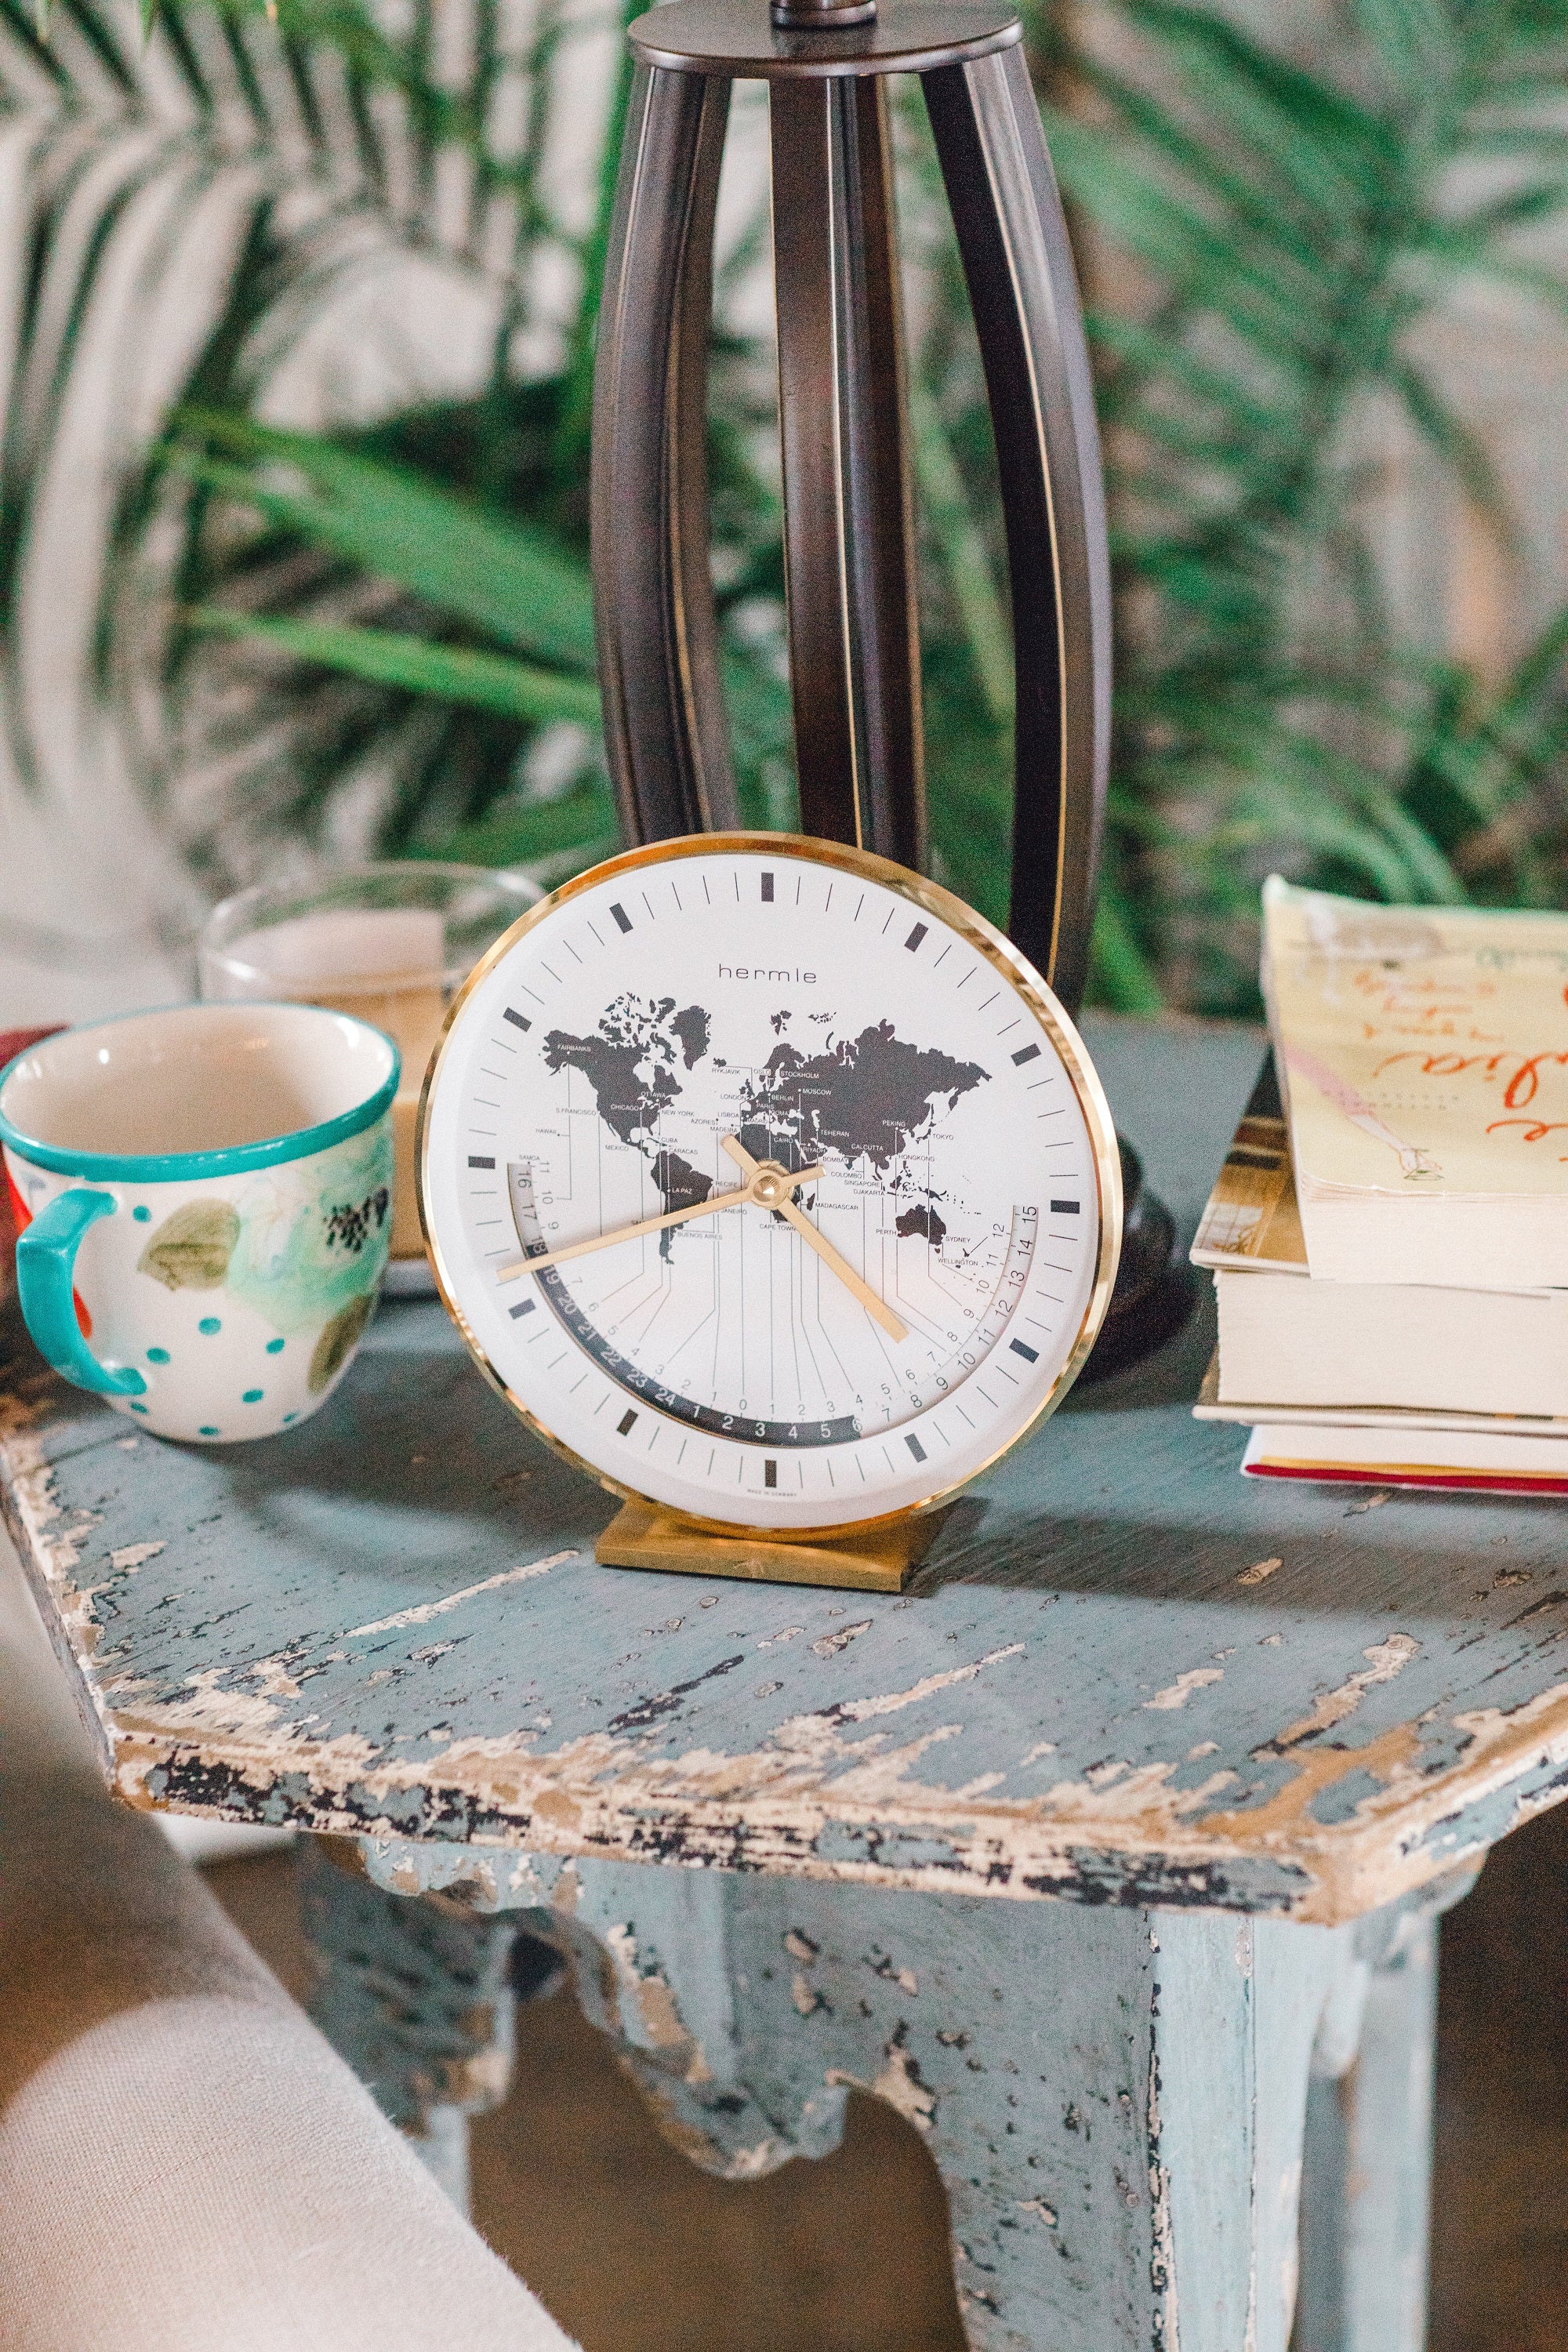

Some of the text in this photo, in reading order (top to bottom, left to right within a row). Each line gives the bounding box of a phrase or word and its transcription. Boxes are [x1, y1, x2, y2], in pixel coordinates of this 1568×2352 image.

[719, 964, 816, 983] hermle
[851, 1143, 884, 1152] CALCUTTA
[898, 1154, 935, 1163] HONGKONG
[540, 1162, 550, 1173] 11
[542, 1191, 554, 1204] 10
[548, 1221, 559, 1230] 9
[993, 1223, 1005, 1238] 12
[938, 1258, 978, 1266] WELLINGTON
[985, 1254, 999, 1267] 11
[572, 1276, 583, 1285] 7
[976, 1279, 989, 1294] 10
[518, 1171, 1037, 1439] 16 17 18 19 20 21 22 23 24 1 2 3 4 5 6 7 8 9 10 11 12 13 14 15
[588, 1301, 599, 1312] 6
[963, 1308, 975, 1319] 9
[608, 1325, 619, 1336] 5
[946, 1331, 958, 1342] 8
[632, 1348, 641, 1356] 4
[927, 1351, 936, 1362] 7
[655, 1364, 665, 1375] 3
[905, 1369, 916, 1380] 6
[681, 1379, 691, 1391] 2
[880, 1383, 891, 1395] 5
[739, 1399, 747, 1410] 0
[855, 1394, 863, 1405] 4
[797, 1404, 806, 1416] 2
[826, 1401, 836, 1413] 3
